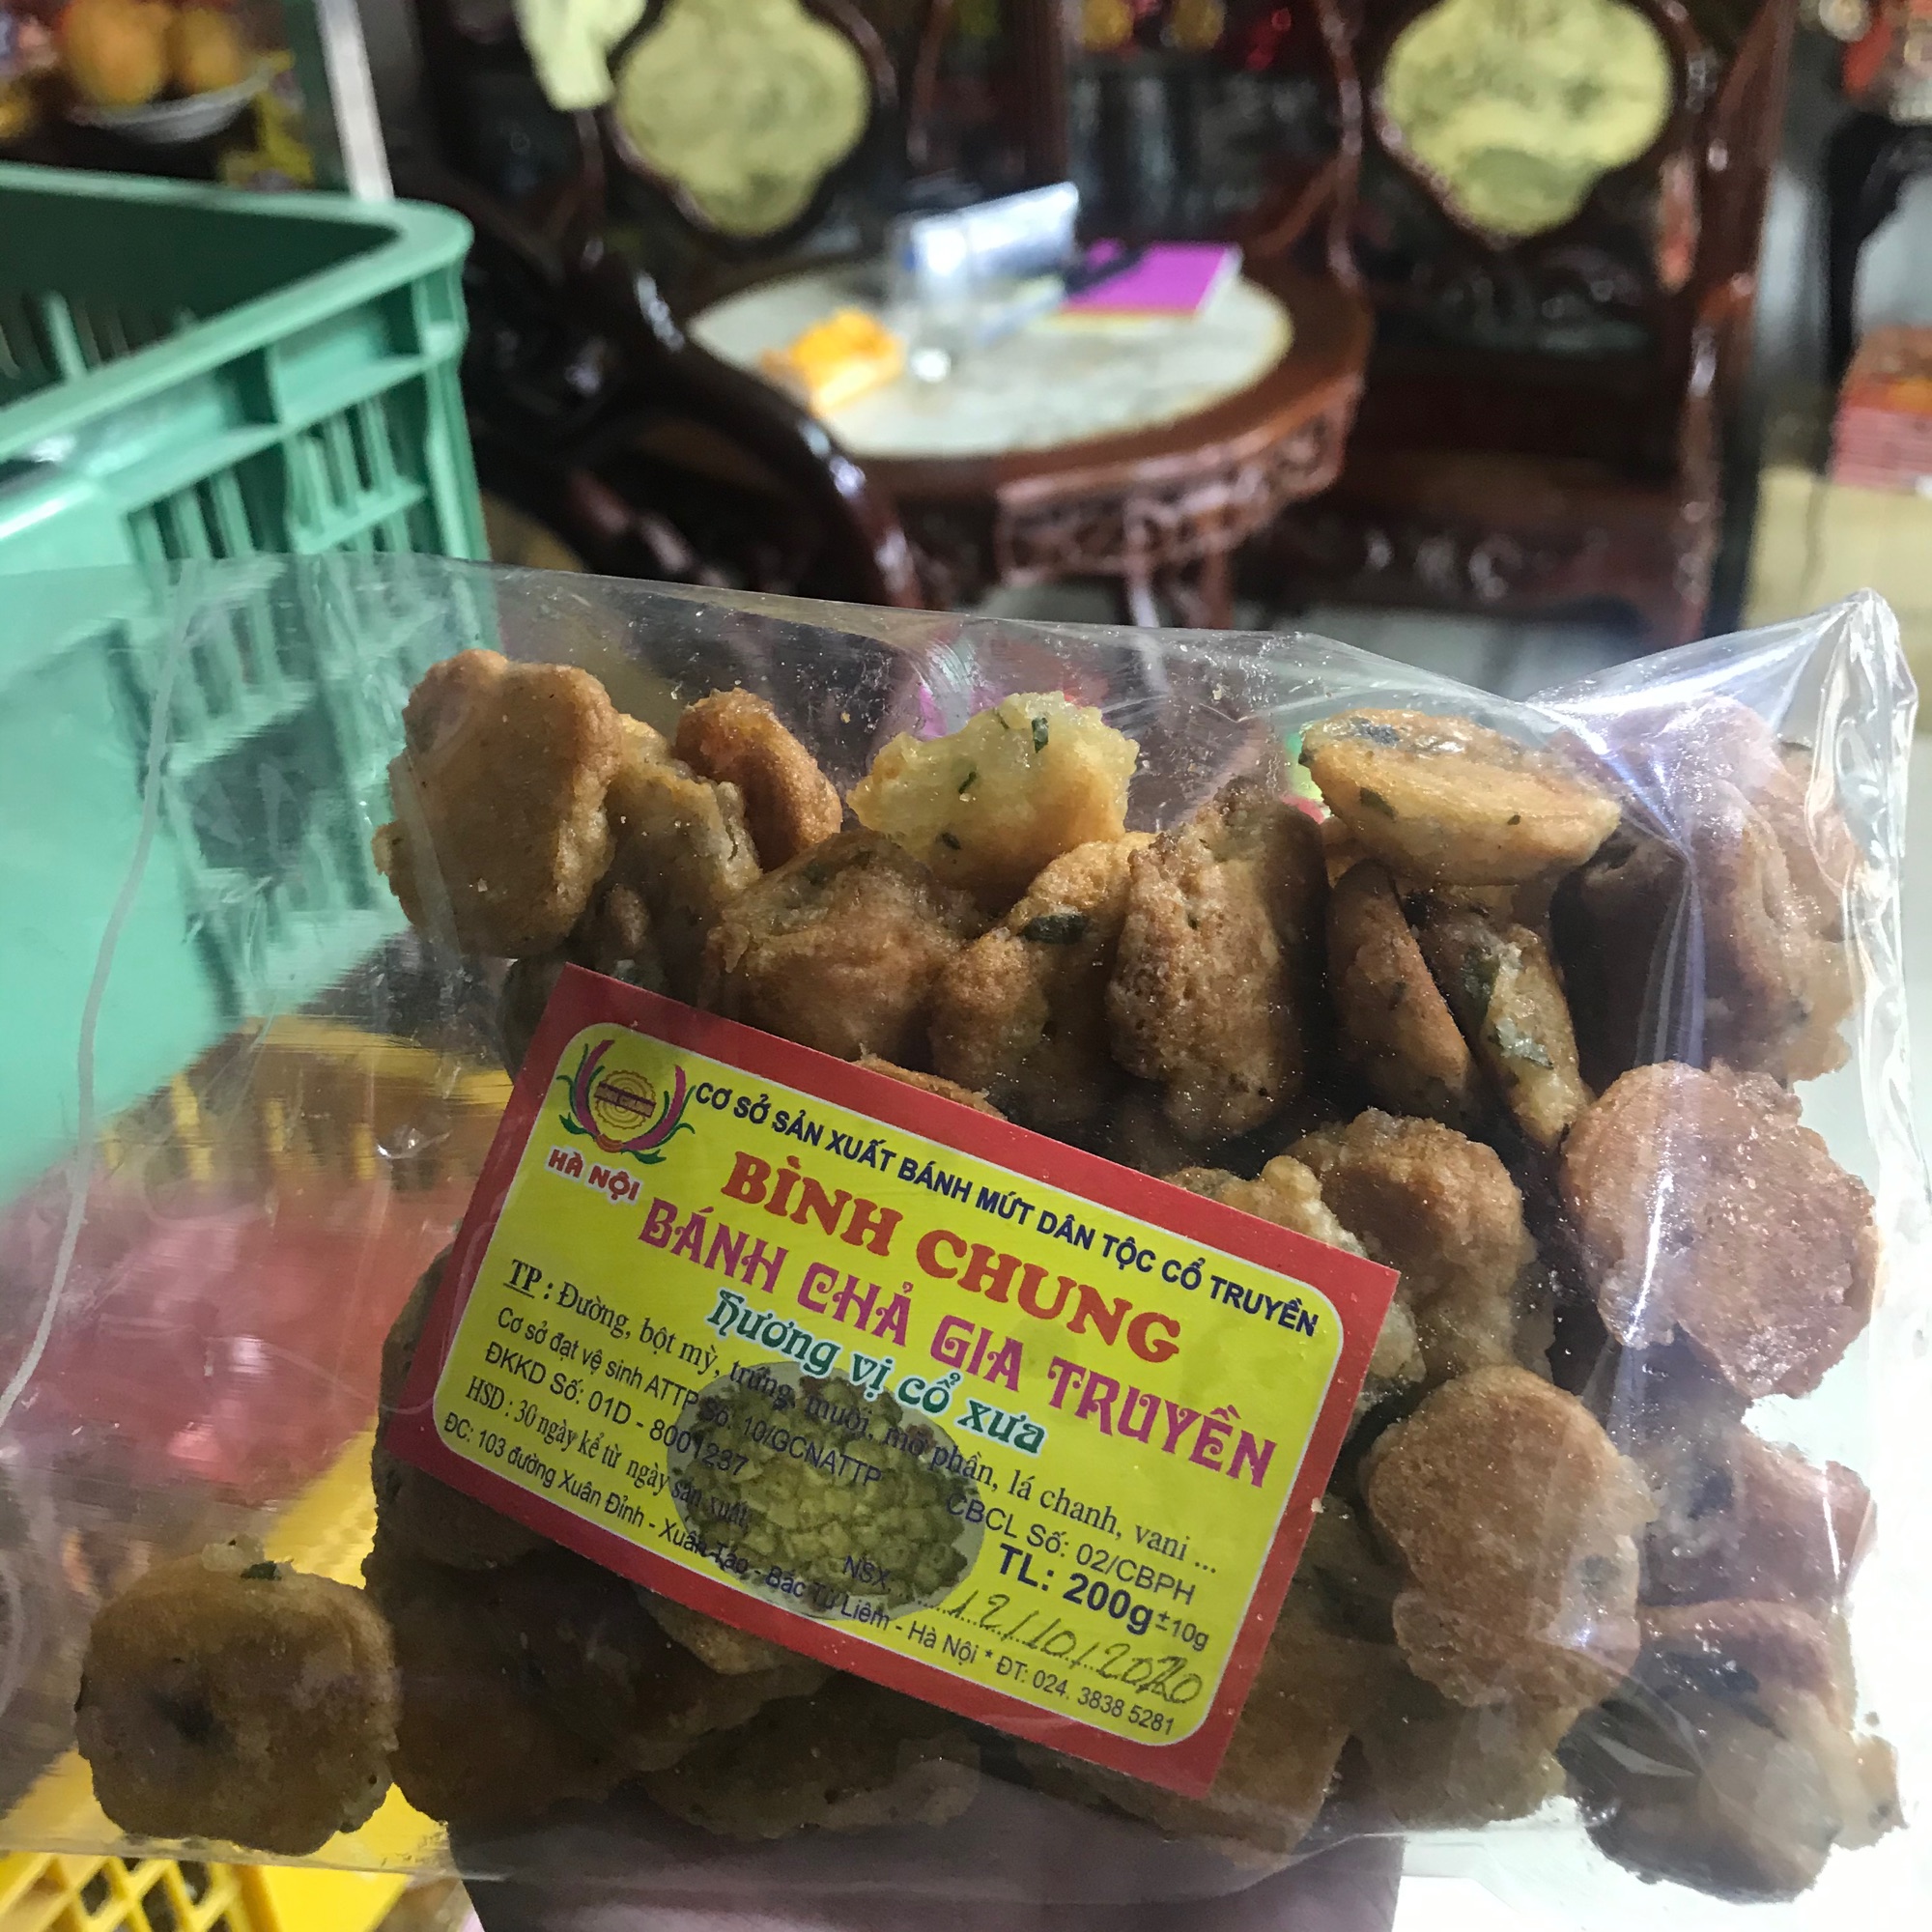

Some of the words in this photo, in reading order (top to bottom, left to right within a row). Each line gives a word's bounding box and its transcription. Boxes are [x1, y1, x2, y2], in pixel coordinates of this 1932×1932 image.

[546, 1145, 585, 1179] HÀ
[585, 1162, 643, 1206] NỘI
[695, 1081, 733, 1111] CƠ
[731, 1093, 772, 1125] SỞ
[771, 1109, 824, 1147] SẢN
[824, 1129, 897, 1172] XUẤT
[896, 1156, 974, 1204] BÁNH
[975, 1186, 1036, 1225] MỨT
[1036, 1210, 1096, 1250] DÂN
[1101, 1233, 1156, 1274] TỘC
[1160, 1257, 1206, 1292] CỔ
[1209, 1274, 1319, 1337] TRUYỀN
[720, 1150, 903, 1257] BÌNH
[916, 1229, 1182, 1364] CHUNG
[484, 1340, 548, 1385] ĐKKD
[548, 1372, 583, 1405] Số:
[586, 1390, 632, 1425] 01D
[646, 1416, 752, 1479] 8001237
[497, 1305, 525, 1334] Cơ
[524, 1321, 549, 1346] sở
[548, 1331, 581, 1361] đạt
[582, 1349, 604, 1376] vệ
[604, 1359, 643, 1389] sinh
[642, 1372, 700, 1413] ATTP
[738, 1414, 884, 1492] 10/GCNATTP
[555, 1280, 631, 1340] Đường,
[639, 1317, 676, 1355] bột
[674, 1335, 727, 1381] mỳ,
[927, 1435, 1007, 1495] phần,
[1008, 1469, 1035, 1501] lá
[1038, 1487, 1122, 1539] chanh,
[1135, 1524, 1188, 1562] vani
[637, 1197, 788, 1294] BÁNH
[796, 1262, 913, 1348] CHẢ
[929, 1314, 1023, 1392] GIA
[1046, 1355, 1277, 1489] TRUYỀN
[840, 1350, 895, 1404] vị
[894, 1368, 963, 1418] cổ
[955, 1396, 1049, 1457] xưa
[466, 1376, 505, 1410] HSD
[514, 1399, 538, 1427] 30
[536, 1415, 579, 1453] ngày
[577, 1430, 605, 1460] kể
[600, 1445, 622, 1469] từ
[621, 1453, 673, 1499] ngày
[441, 1411, 474, 1440] ĐC:
[478, 1430, 506, 1458] 103
[506, 1445, 556, 1489] đường
[556, 1469, 603, 1506] Xuân
[603, 1491, 644, 1527] Đỉnh
[657, 1518, 711, 1556] Xuân
[839, 1593, 893, 1632] Liêm
[907, 1621, 940, 1649] Hà
[942, 1634, 978, 1665] Nội
[995, 1655, 1028, 1680] ĐT:
[1032, 1669, 1070, 1699] 024.
[1077, 1686, 1124, 1719] 3838
[1127, 1704, 1174, 1732] 5281
[944, 1489, 1024, 1540] CBCL
[1025, 1523, 1068, 1557] Số:
[1075, 1543, 1196, 1606] 02/CBPH
[999, 1543, 1054, 1592] TL:
